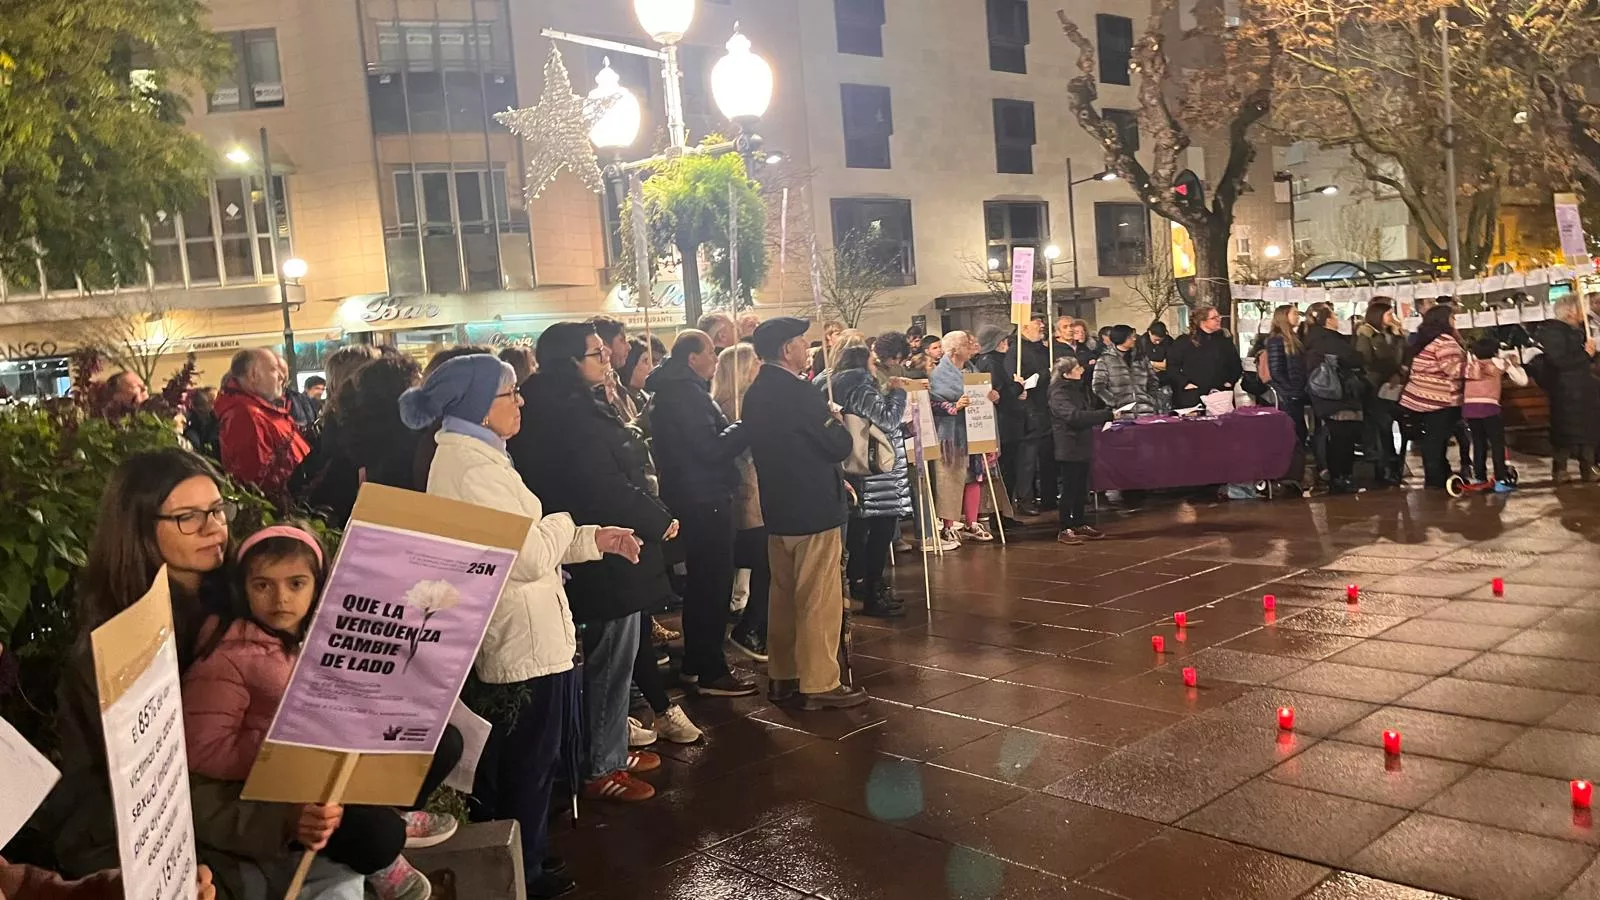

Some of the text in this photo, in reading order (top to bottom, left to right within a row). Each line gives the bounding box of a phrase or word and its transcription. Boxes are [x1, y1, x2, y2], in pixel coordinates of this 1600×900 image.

[362, 295, 440, 322] Bar
[466, 562, 496, 576] 25N
[342, 594, 405, 620] QUE LA
[335, 615, 442, 643] VERGÜENZA
[328, 633, 402, 656] CAMBIE
[320, 653, 395, 675] DE LADO
[132, 775, 158, 823] sexual
